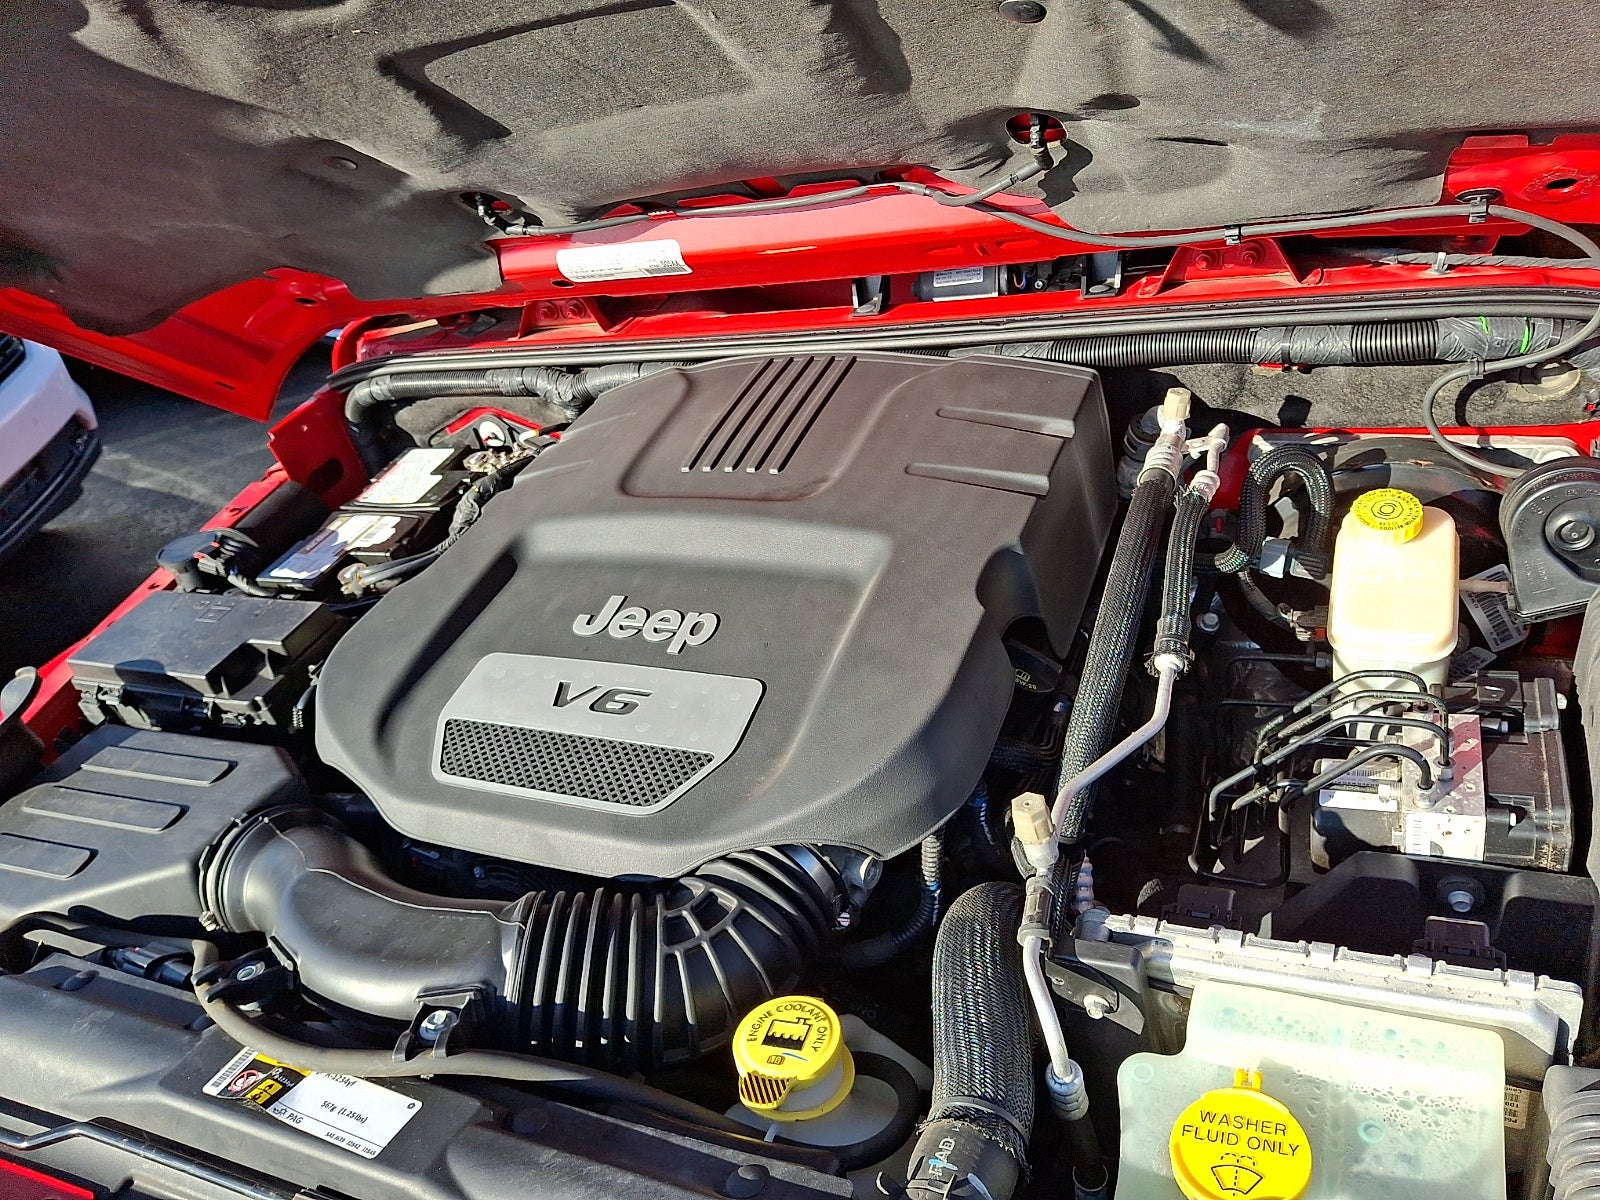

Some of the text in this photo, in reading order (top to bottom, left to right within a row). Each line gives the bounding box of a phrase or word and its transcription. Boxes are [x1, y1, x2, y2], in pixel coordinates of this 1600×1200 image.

[572, 595, 721, 655] Jeep
[552, 680, 654, 716] V6
[747, 1010, 773, 1042] ENGINE
[776, 1003, 827, 1023] COOLANT
[811, 1026, 828, 1052] ONLY
[286, 1112, 304, 1125] PAG
[1200, 1109, 1287, 1137] WASHER
[1181, 1124, 1300, 1157] FLUID ONLY
